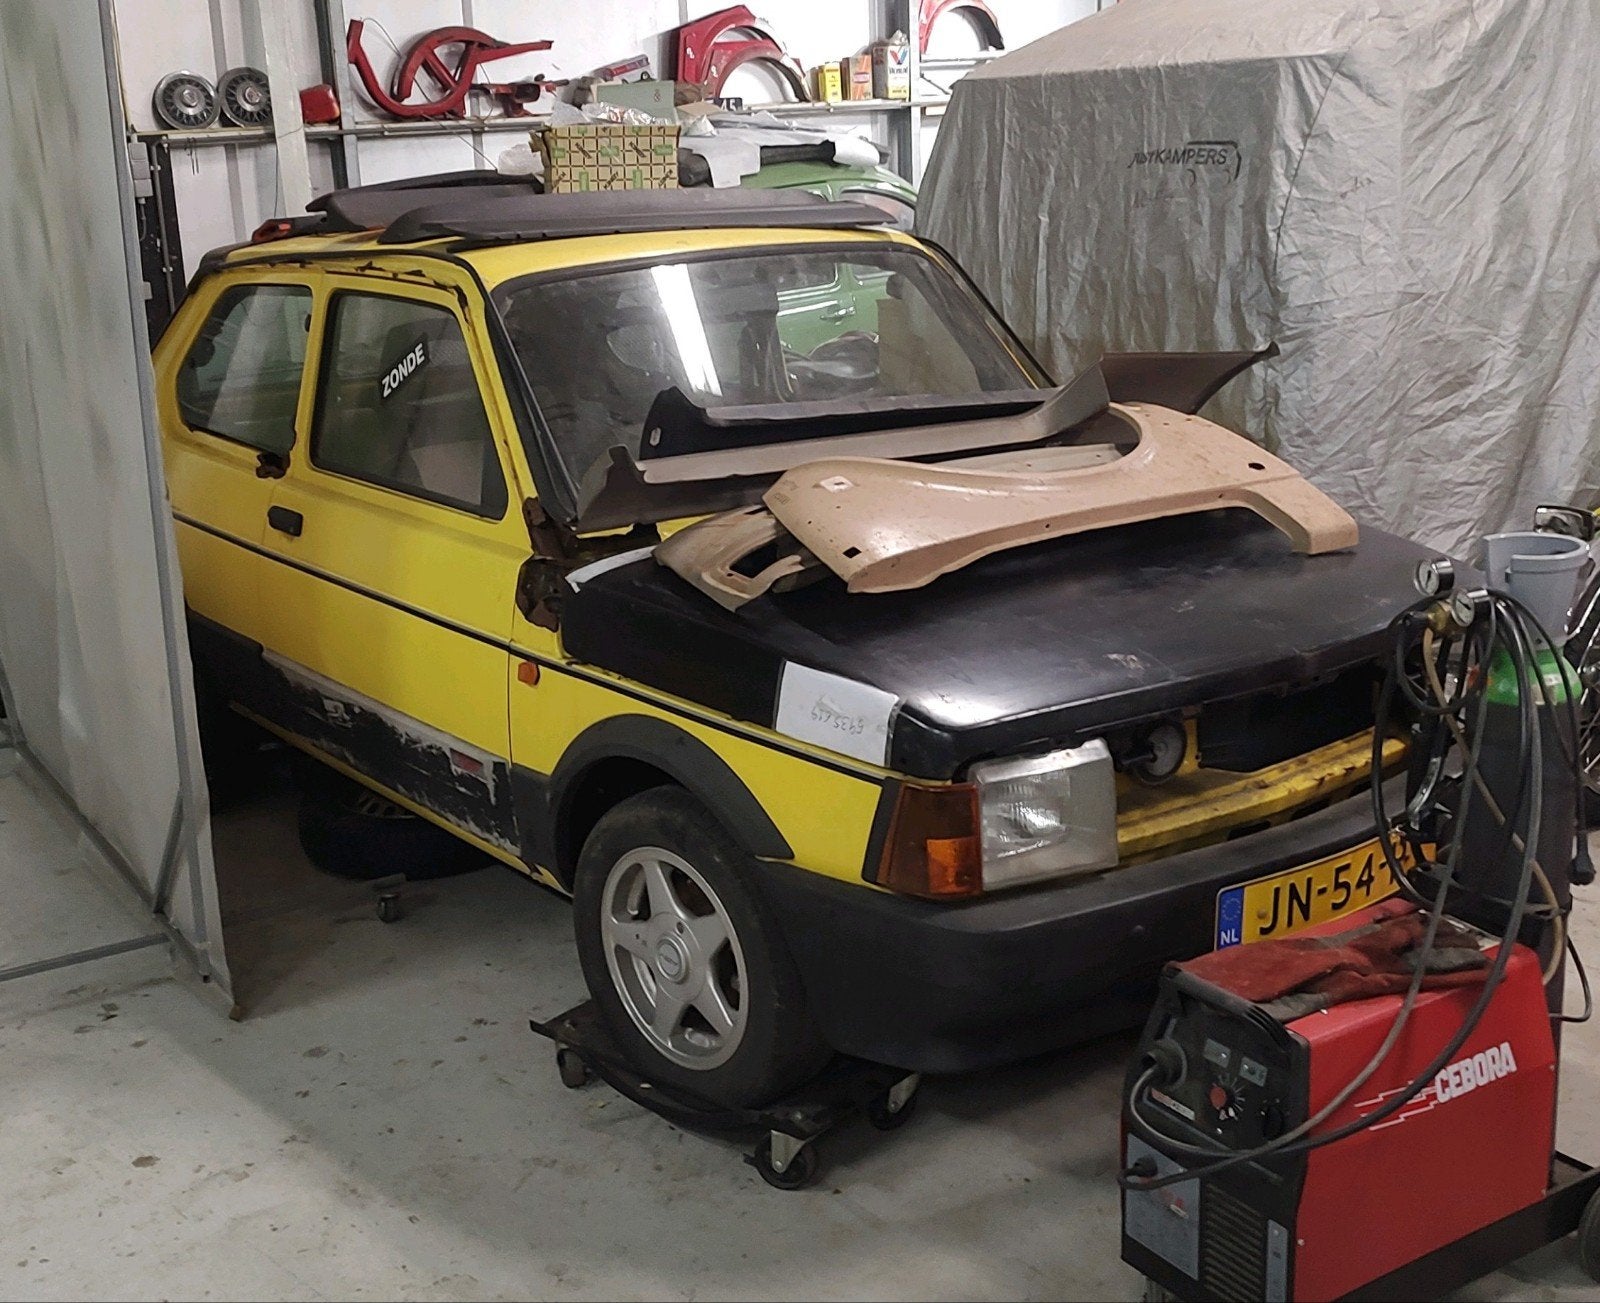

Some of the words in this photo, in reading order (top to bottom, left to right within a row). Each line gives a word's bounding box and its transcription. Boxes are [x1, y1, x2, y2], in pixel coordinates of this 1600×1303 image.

[381, 342, 425, 398] ZONDE
[1259, 842, 1409, 936] JN-54-
[1220, 929, 1240, 946] NL
[1435, 1041, 1517, 1103] CEBORA
